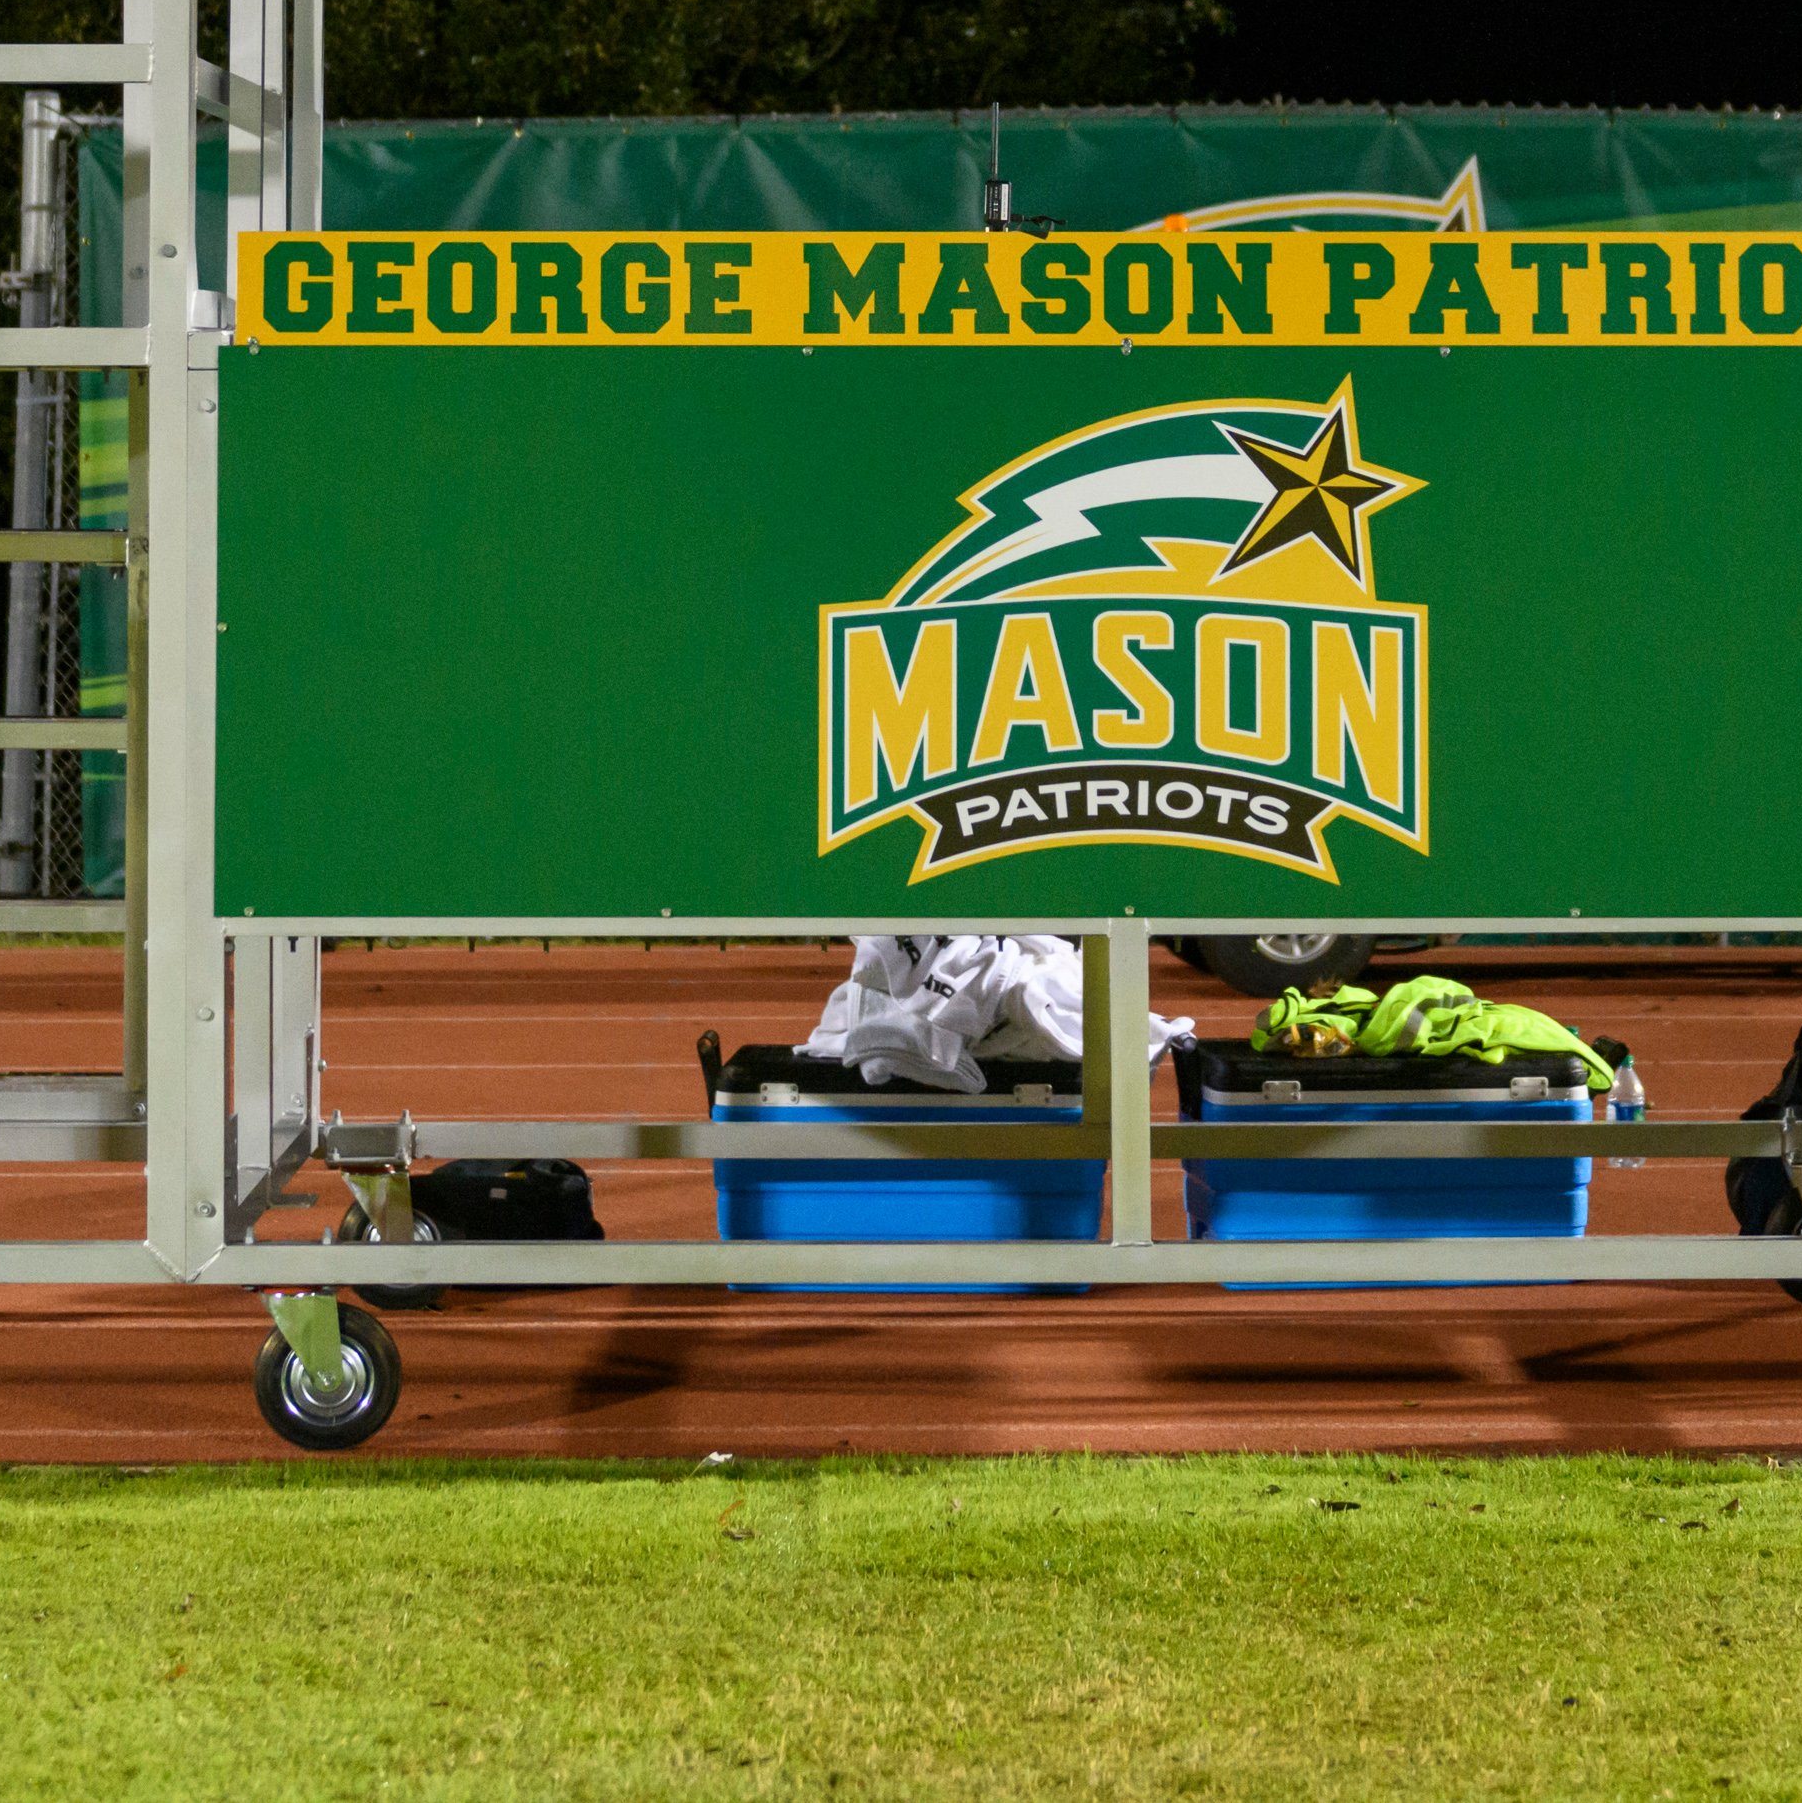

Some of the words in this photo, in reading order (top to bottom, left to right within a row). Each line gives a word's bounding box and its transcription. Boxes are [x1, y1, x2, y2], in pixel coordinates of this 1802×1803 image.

[262, 240, 754, 334] GEORGE
[802, 241, 1274, 335] MASON
[842, 610, 1405, 815] MASON
[955, 780, 1290, 837] PATRIOTS
